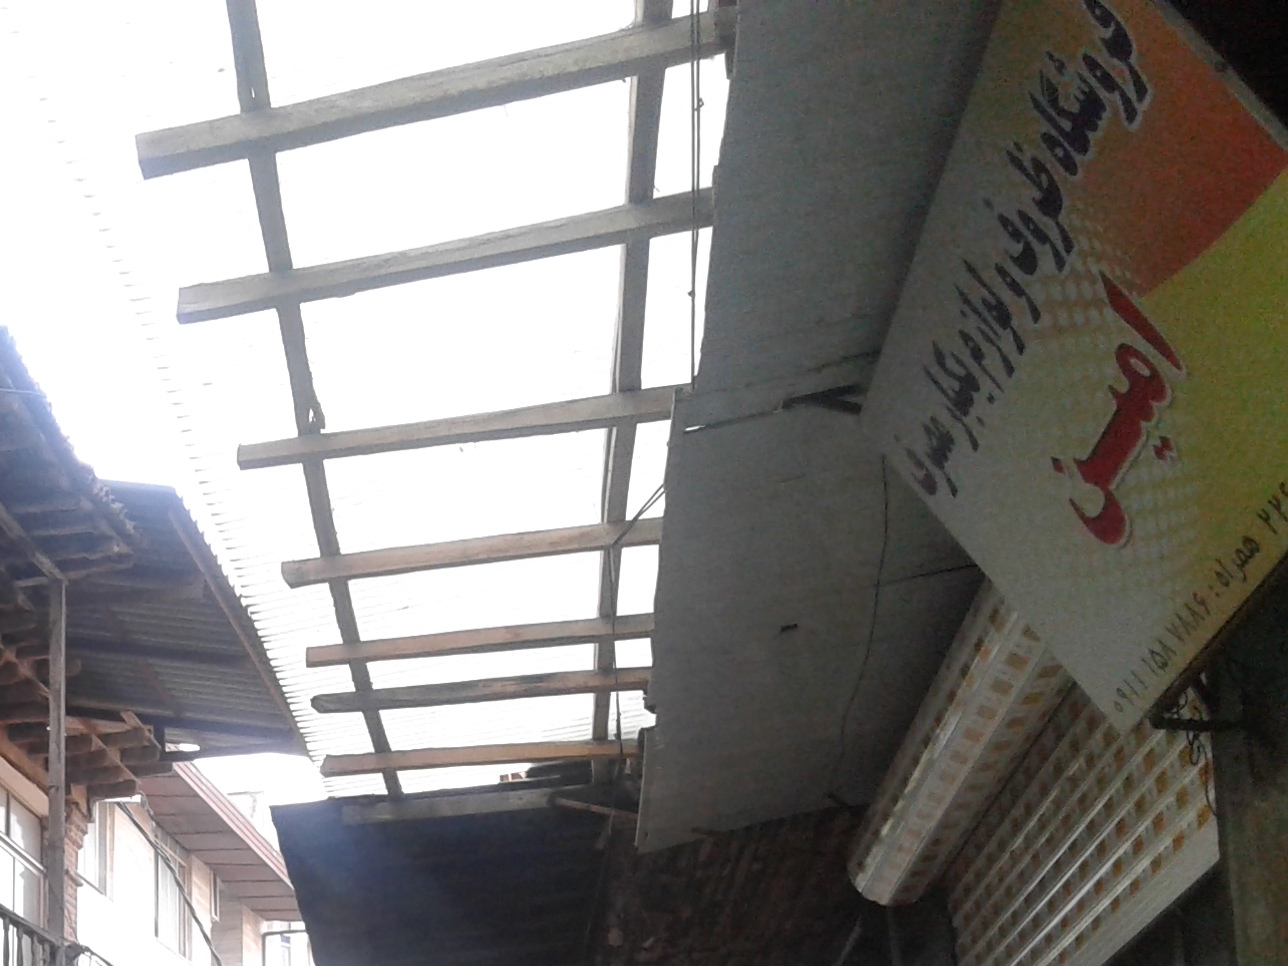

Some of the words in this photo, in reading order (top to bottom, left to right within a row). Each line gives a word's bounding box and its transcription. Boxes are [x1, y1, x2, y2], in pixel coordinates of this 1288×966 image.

[983, 141, 1075, 276] ظروف
[953, 257, 1026, 394] لوازم
[994, 262, 1042, 325] و
[893, 414, 959, 498] مصرف
[1050, 270, 1183, 545] امین
